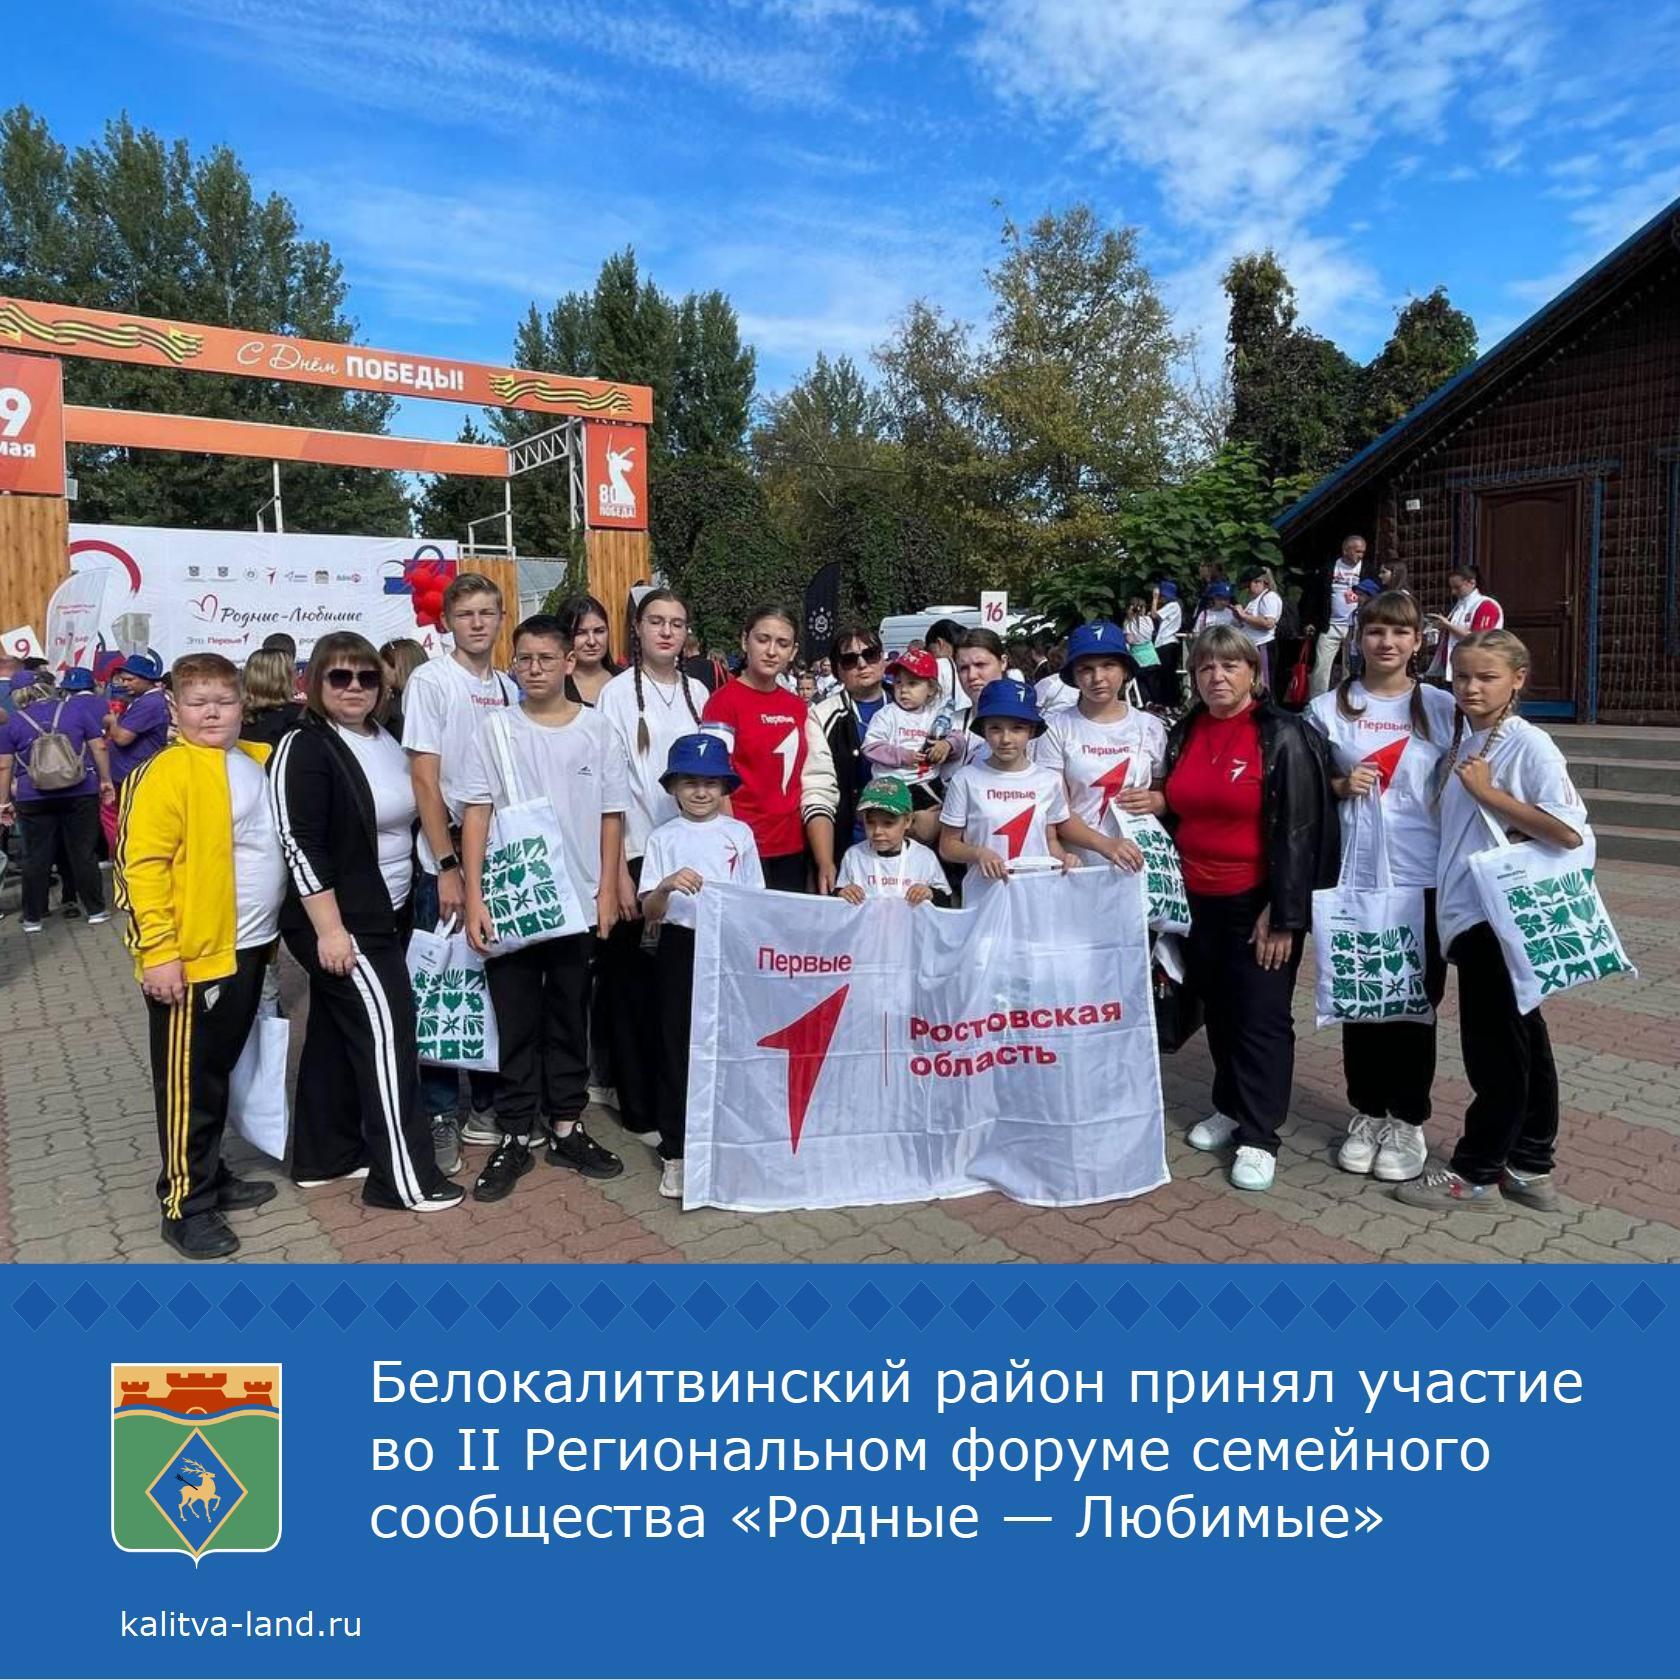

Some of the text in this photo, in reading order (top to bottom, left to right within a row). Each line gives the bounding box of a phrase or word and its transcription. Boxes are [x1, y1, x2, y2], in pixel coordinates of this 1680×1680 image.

[236, 341, 464, 391] С Днём ПОБЕДЫ!
[0, 387, 32, 438] 9
[599, 484, 617, 503] 80
[985, 602, 1003, 622] 16
[14, 638, 31, 658] 9
[422, 633, 435, 650] 4
[1358, 719, 1411, 733] Первые
[1081, 744, 1131, 757] Первые
[986, 788, 1036, 802] Первые
[758, 946, 852, 979] Первые
[909, 1001, 1122, 1042] Ростовская
[909, 1043, 1057, 1079] область
